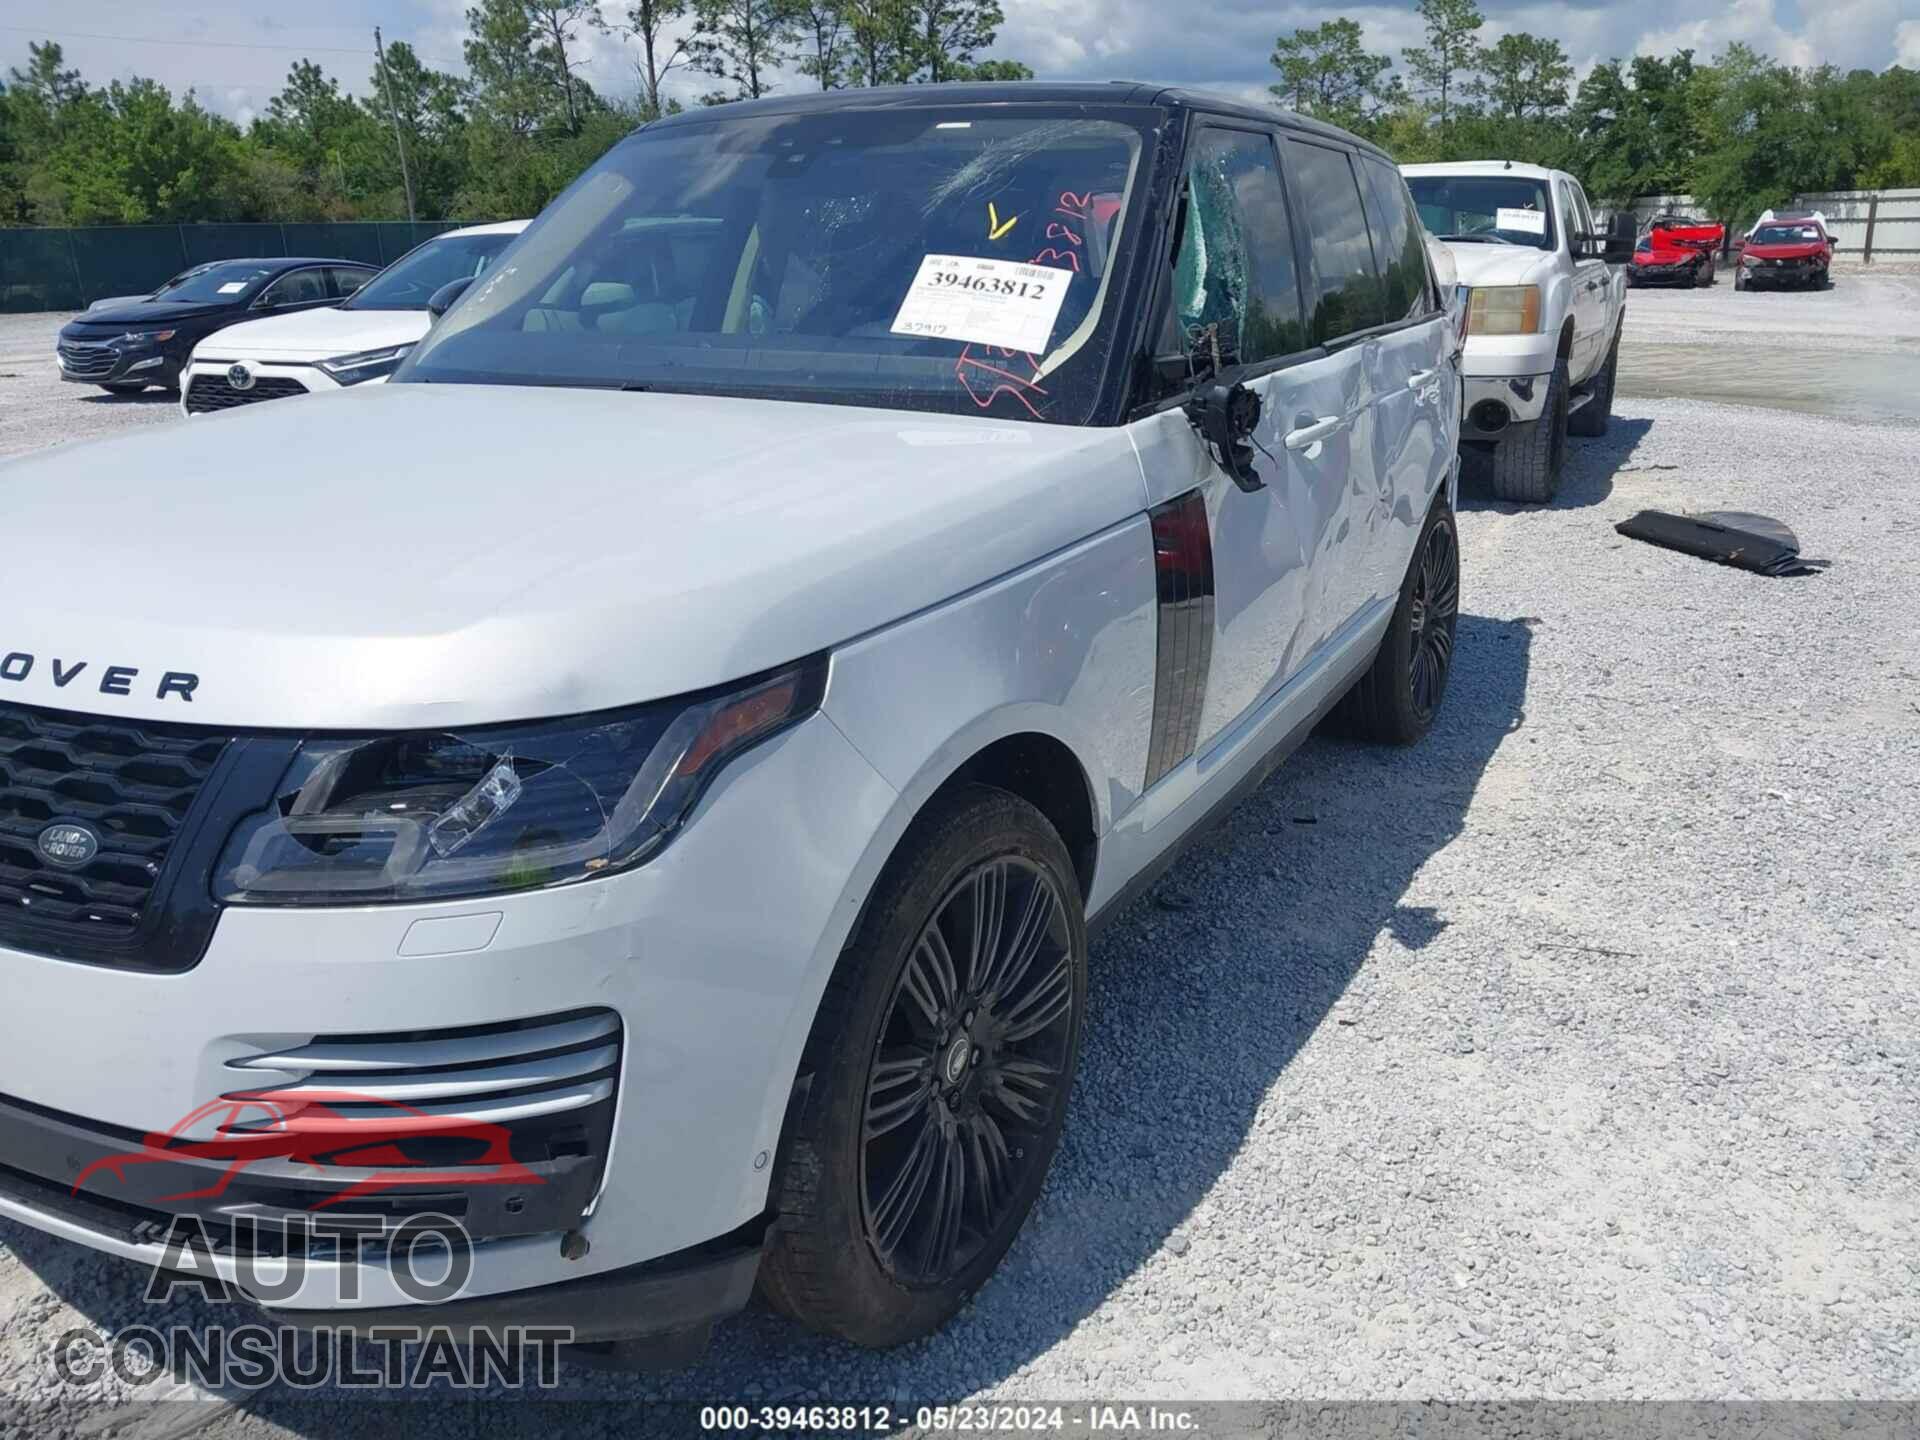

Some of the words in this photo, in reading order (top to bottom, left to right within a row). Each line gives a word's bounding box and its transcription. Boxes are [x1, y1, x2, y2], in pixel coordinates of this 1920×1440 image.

[927, 271, 1046, 300] 39463812
[0, 652, 200, 702] OVER
[48, 829, 80, 843] LAND
[48, 842, 86, 859] ROVER
